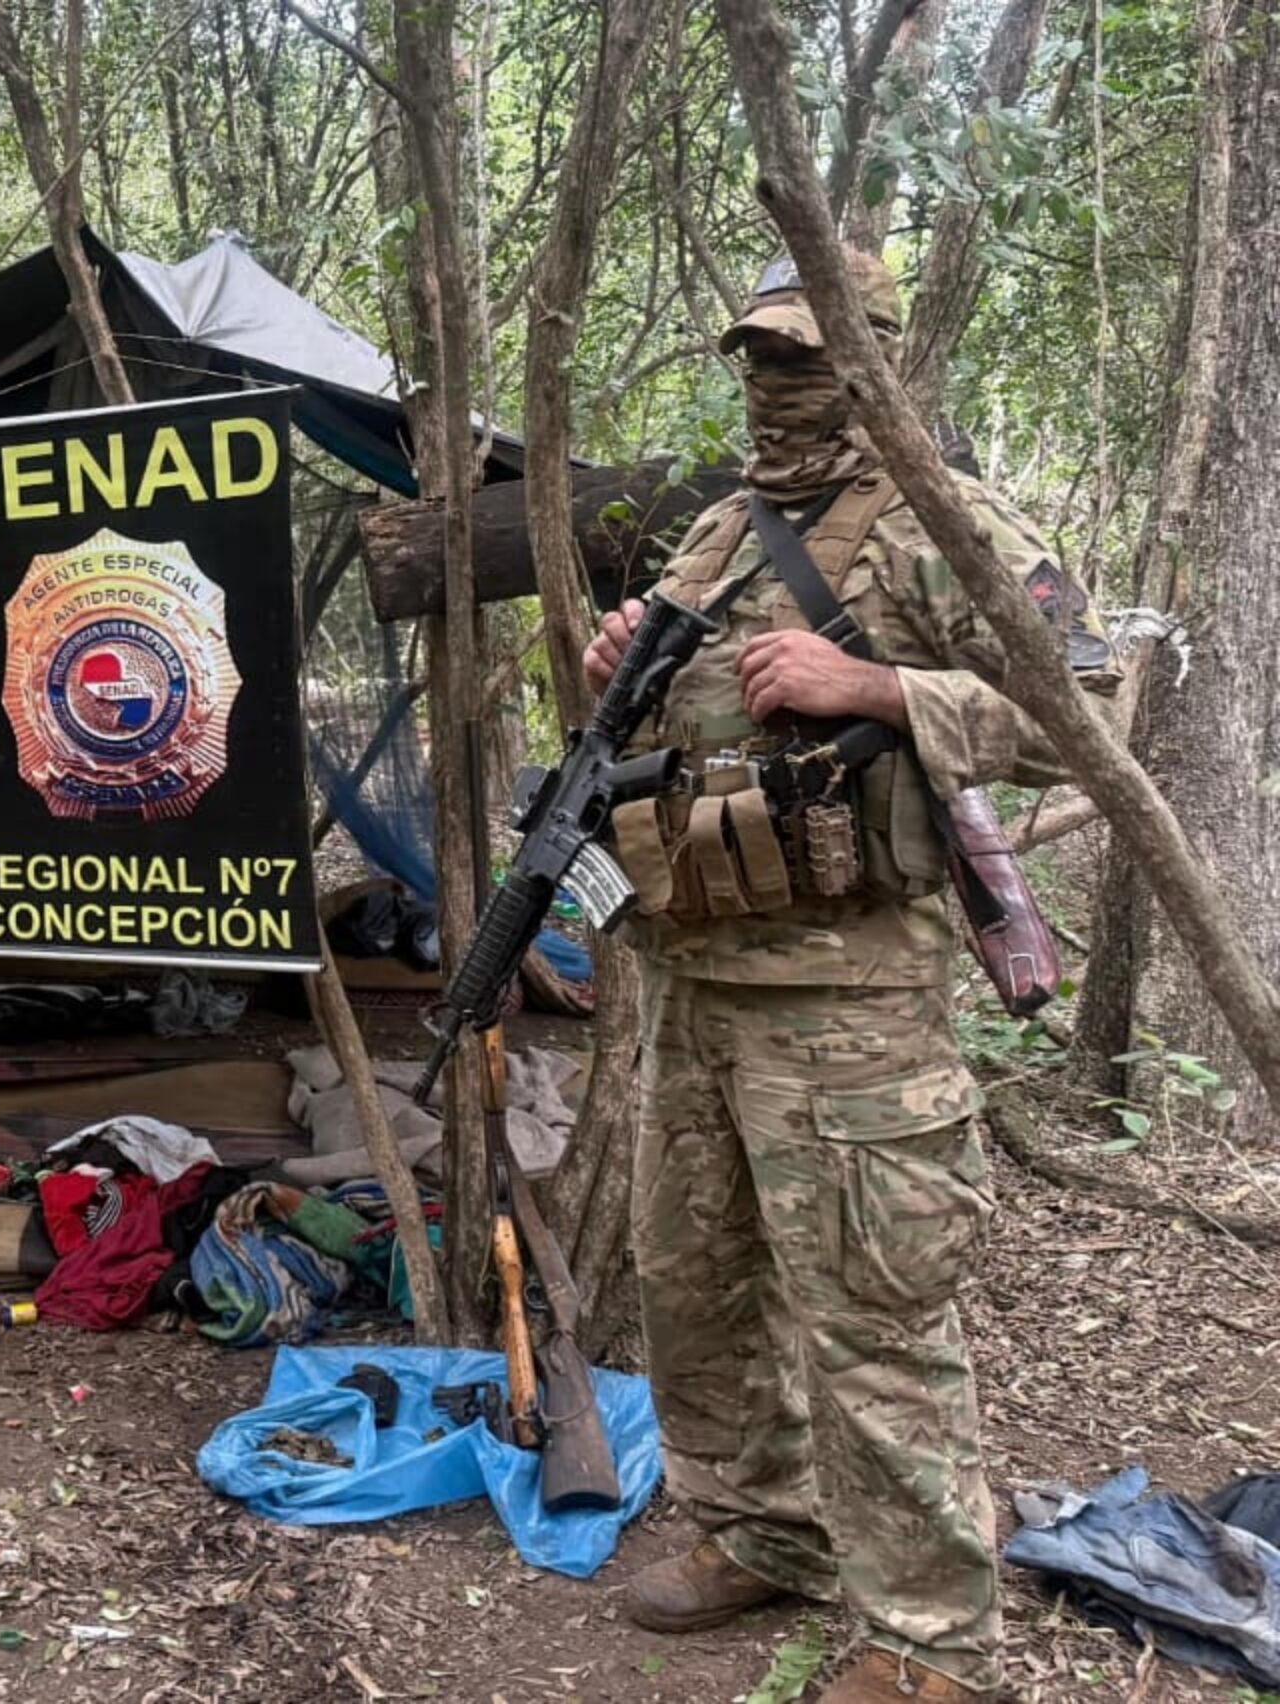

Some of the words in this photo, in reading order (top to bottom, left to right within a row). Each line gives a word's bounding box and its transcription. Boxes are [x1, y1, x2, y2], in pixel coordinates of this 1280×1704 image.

[23, 556, 94, 610] AGENTE
[103, 553, 202, 601] ESPECIAL
[53, 588, 173, 625] ANTIDROGAS
